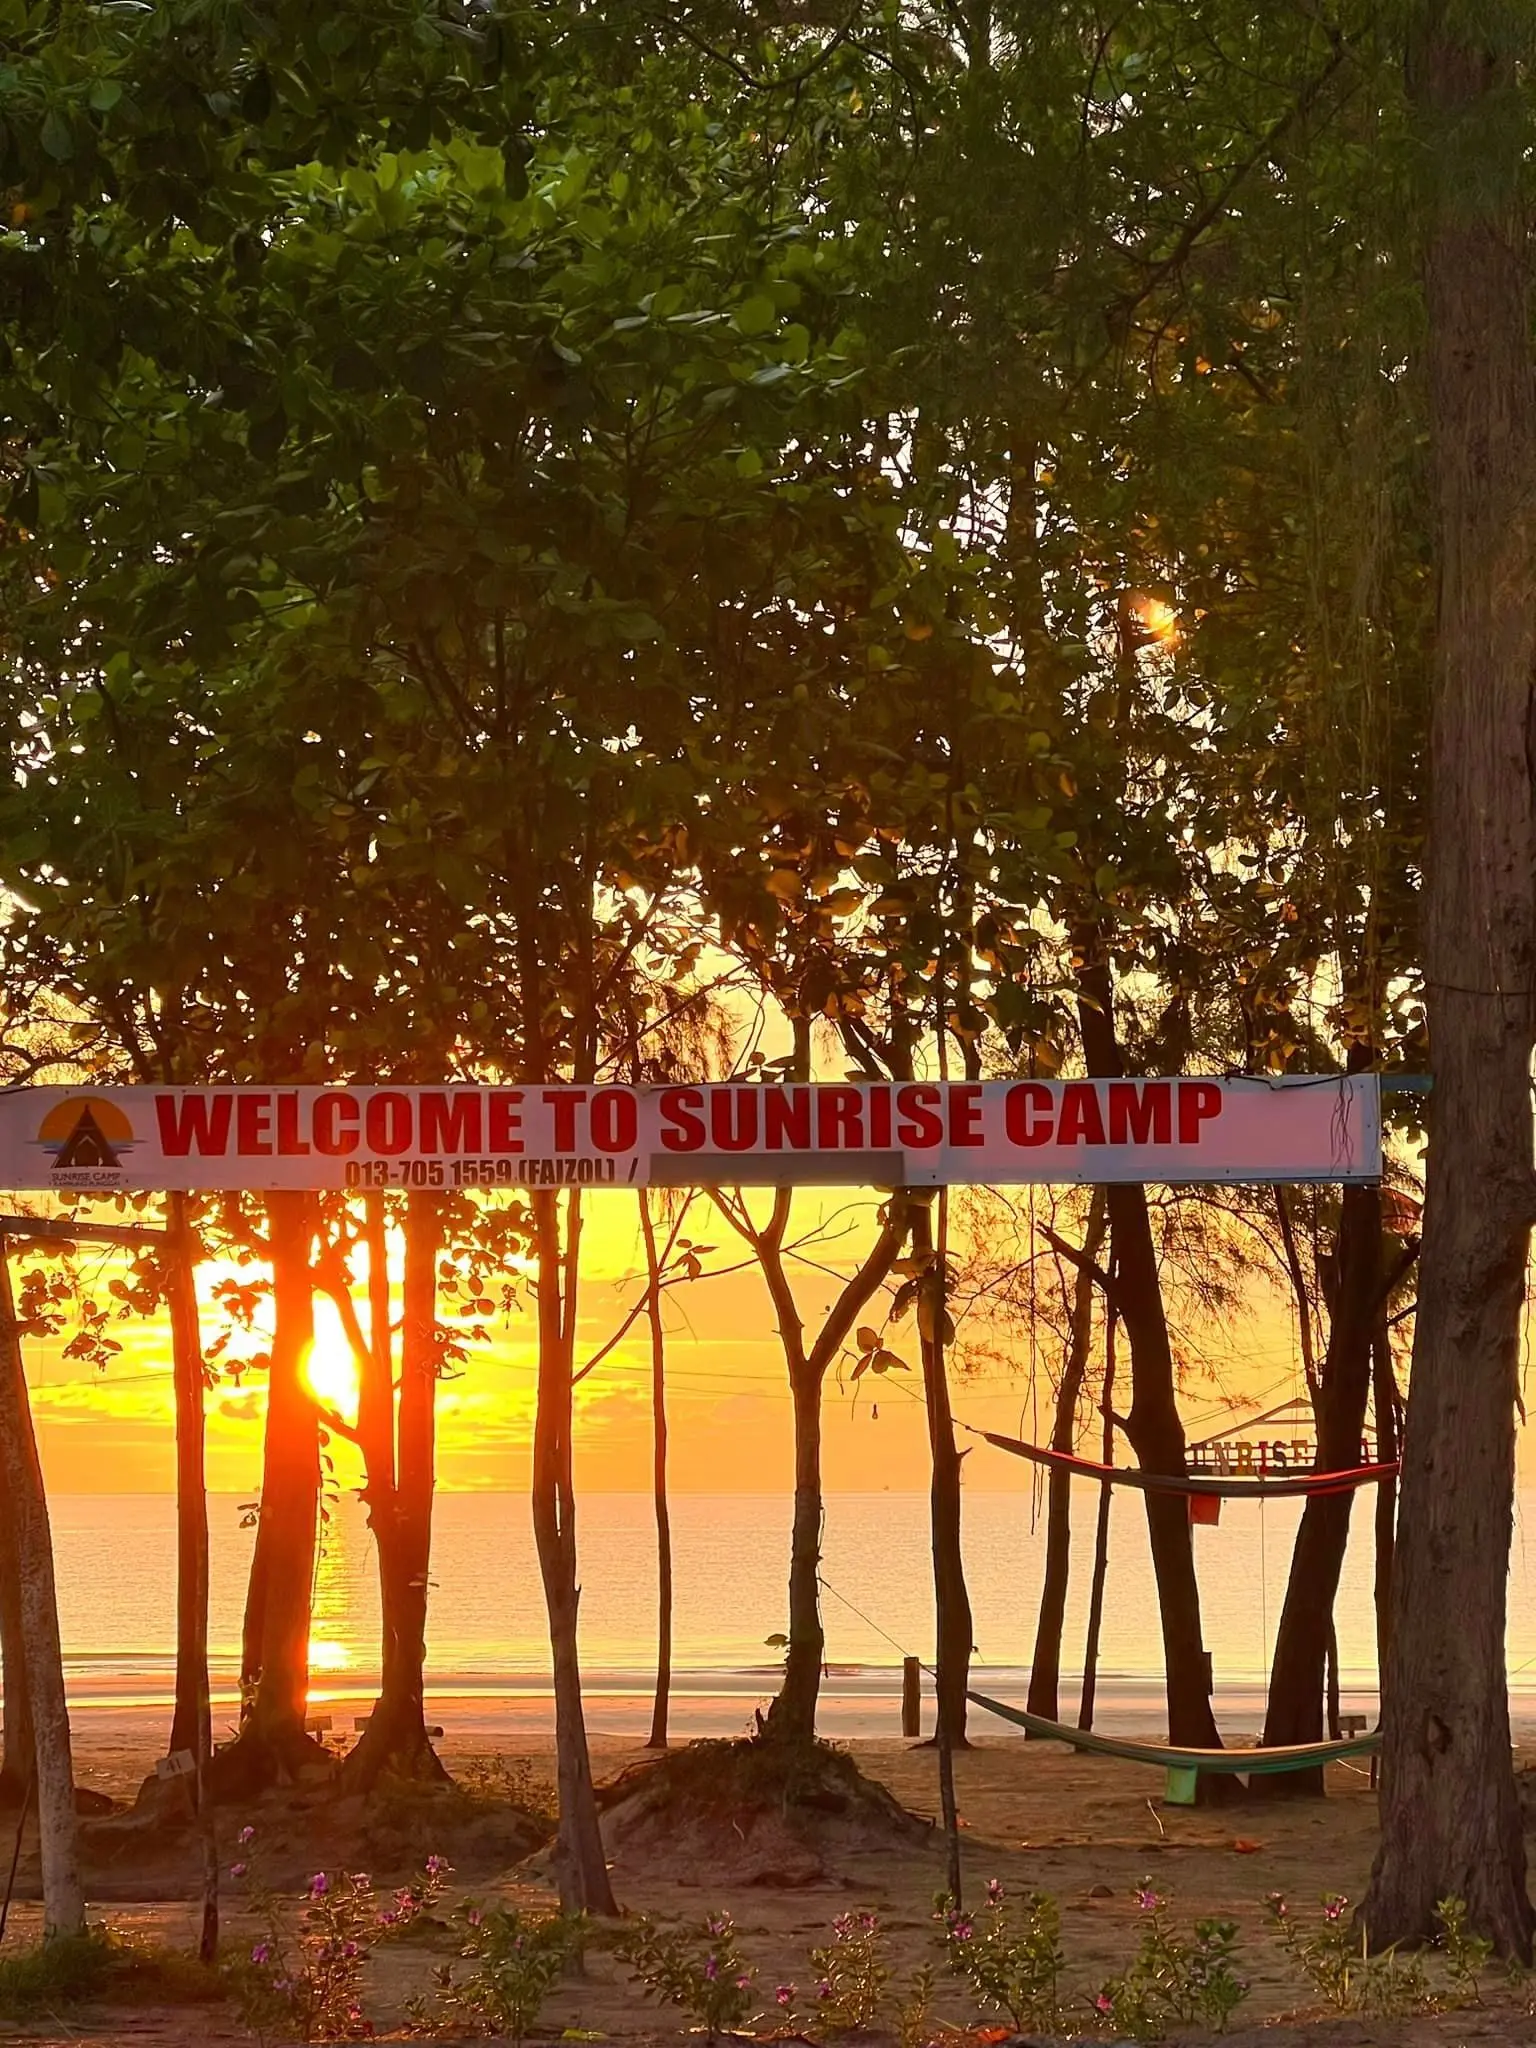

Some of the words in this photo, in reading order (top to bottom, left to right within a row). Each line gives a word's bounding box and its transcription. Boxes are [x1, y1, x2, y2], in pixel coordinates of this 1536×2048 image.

[155, 1091, 524, 1156] WELCOME
[543, 1090, 638, 1153] TO
[660, 1085, 984, 1151] SUNRISE
[1005, 1082, 1222, 1147] CAMP
[52, 1172, 91, 1181] SUNRISE
[92, 1172, 121, 1181] CAMP
[345, 1160, 444, 1187] 013-705
[450, 1159, 512, 1186] 1559
[518, 1158, 615, 1185] (FAIZOL)
